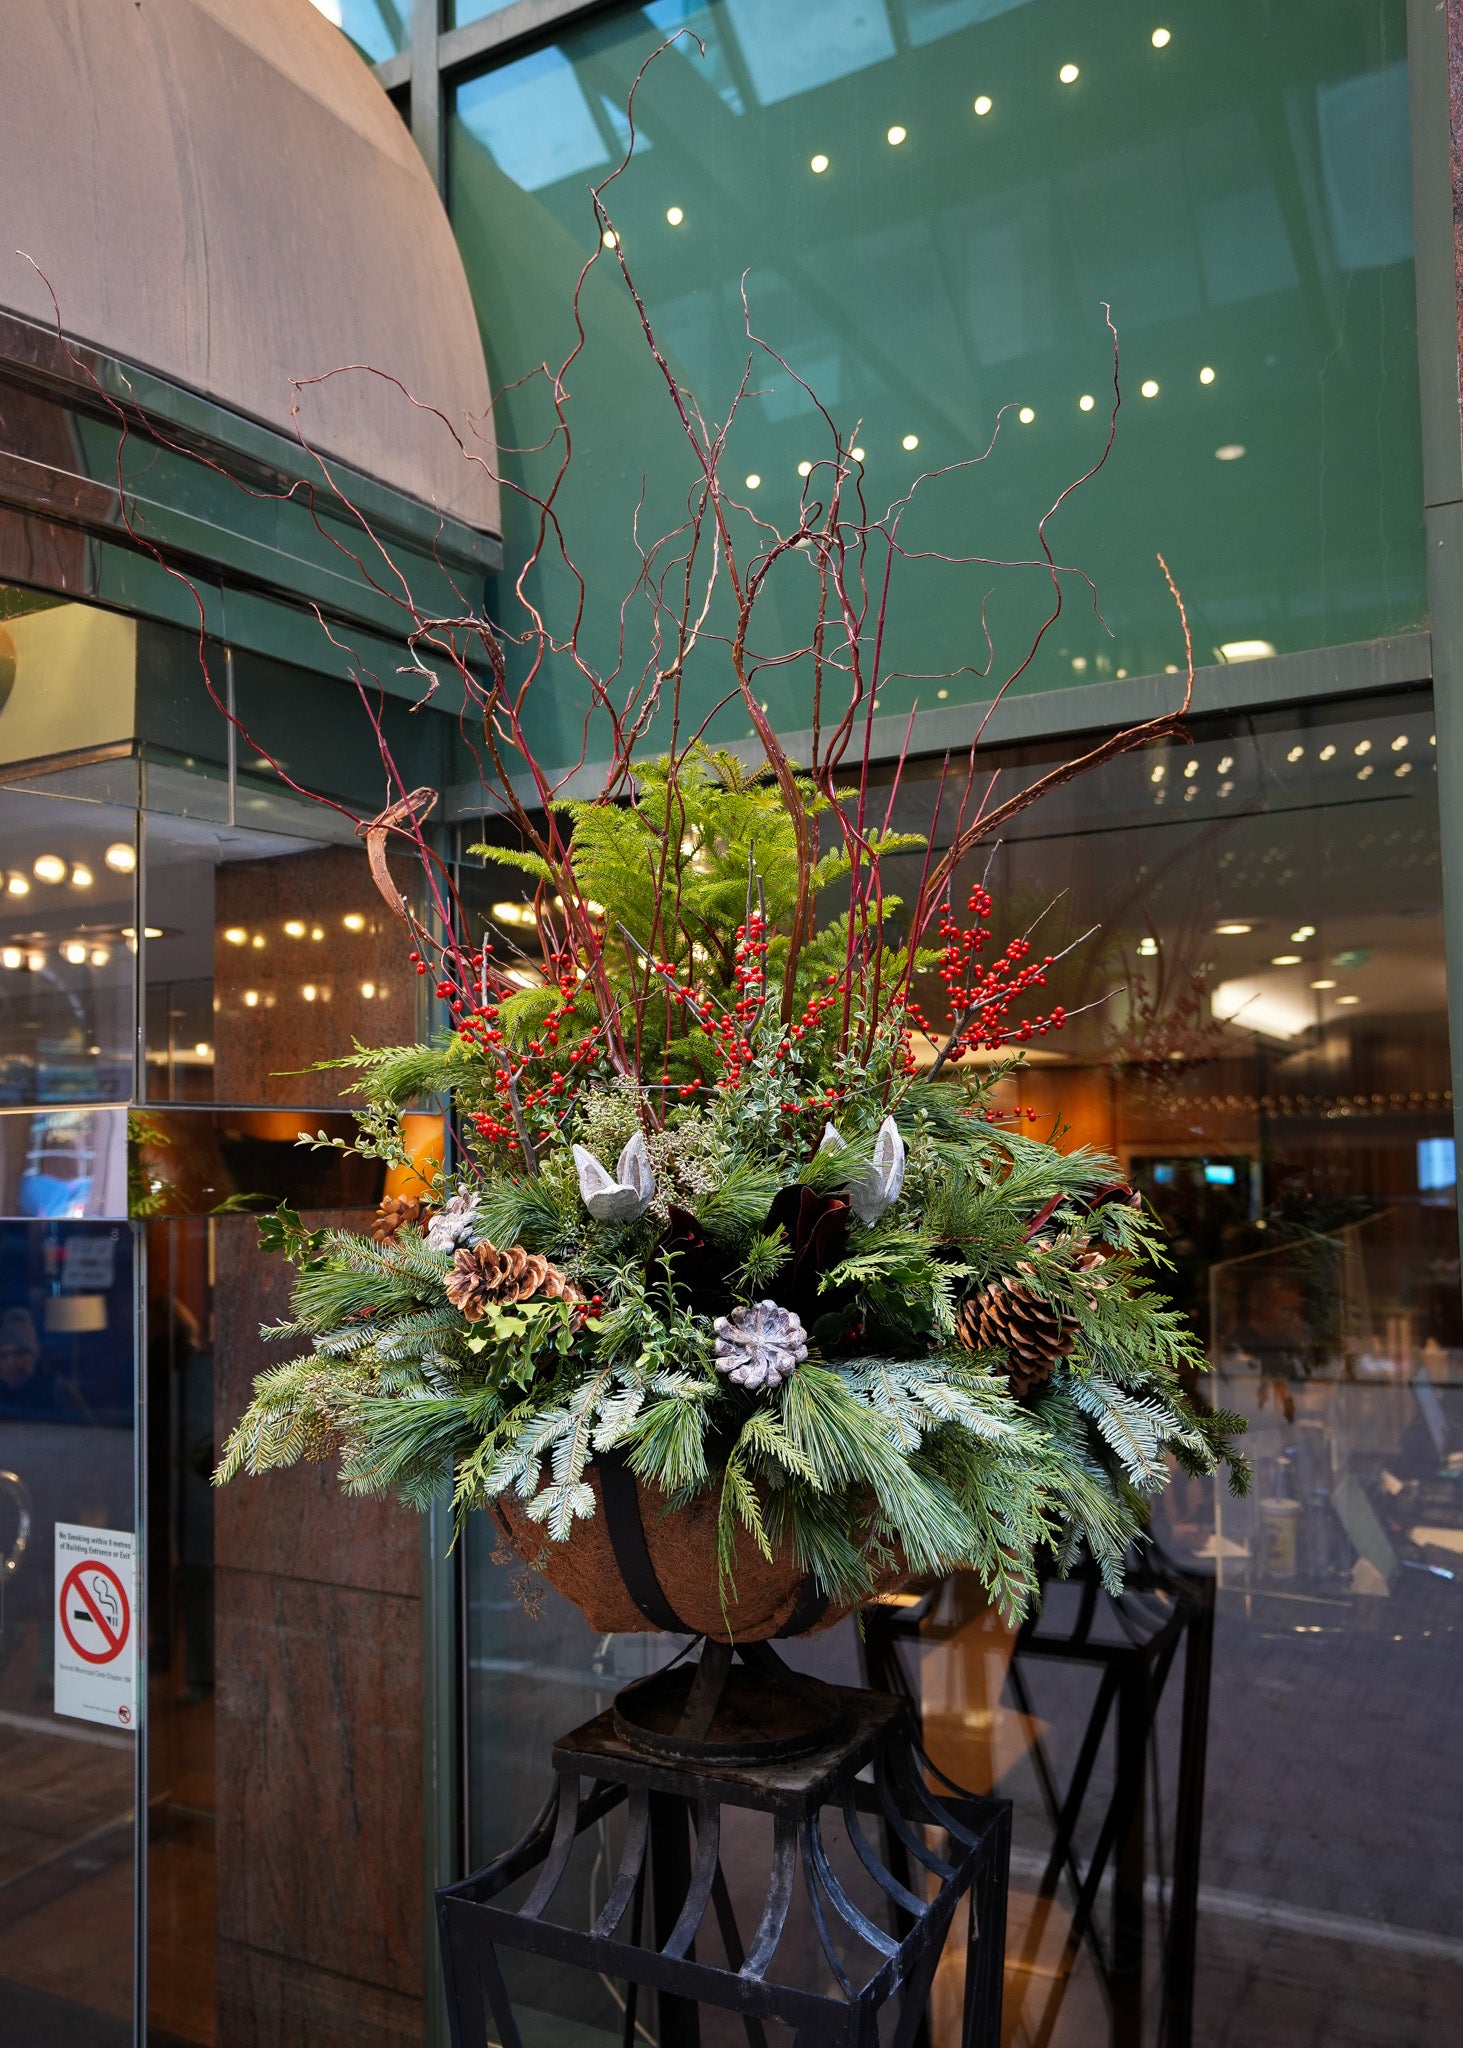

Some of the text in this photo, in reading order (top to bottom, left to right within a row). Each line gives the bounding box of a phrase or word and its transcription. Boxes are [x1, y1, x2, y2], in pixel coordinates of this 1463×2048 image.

[58, 1532, 66, 1540] No
[67, 1533, 90, 1544] Smoking
[91, 1537, 108, 1546] within
[113, 1541, 131, 1550] metres
[66, 1543, 88, 1555] Building
[88, 1546, 112, 1557] Entrance
[119, 1551, 131, 1560] Exit
